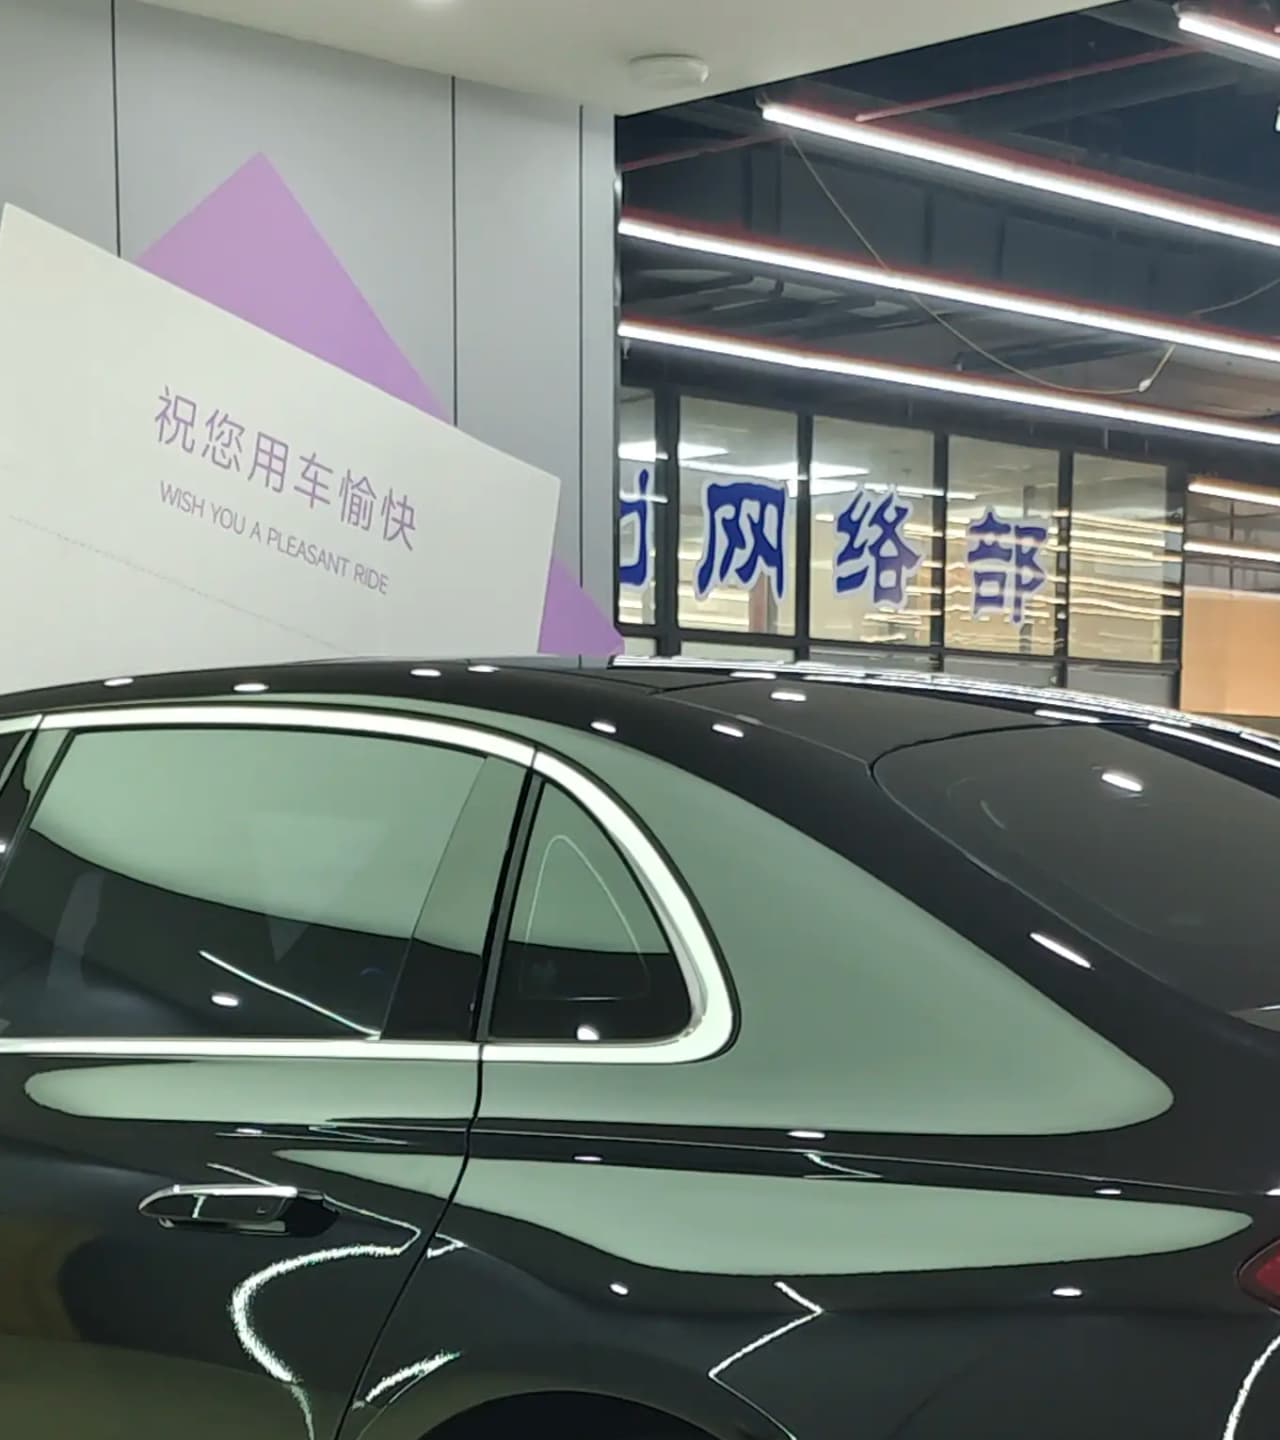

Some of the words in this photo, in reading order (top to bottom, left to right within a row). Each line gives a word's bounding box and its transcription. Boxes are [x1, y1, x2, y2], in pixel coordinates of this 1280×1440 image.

[154, 384, 417, 552] 祝您用车愉快
[160, 480, 206, 519] WISH
[210, 502, 247, 536] YOU
[249, 521, 262, 544] A
[266, 526, 350, 578] PLEASANT
[353, 562, 390, 596] RIDE
